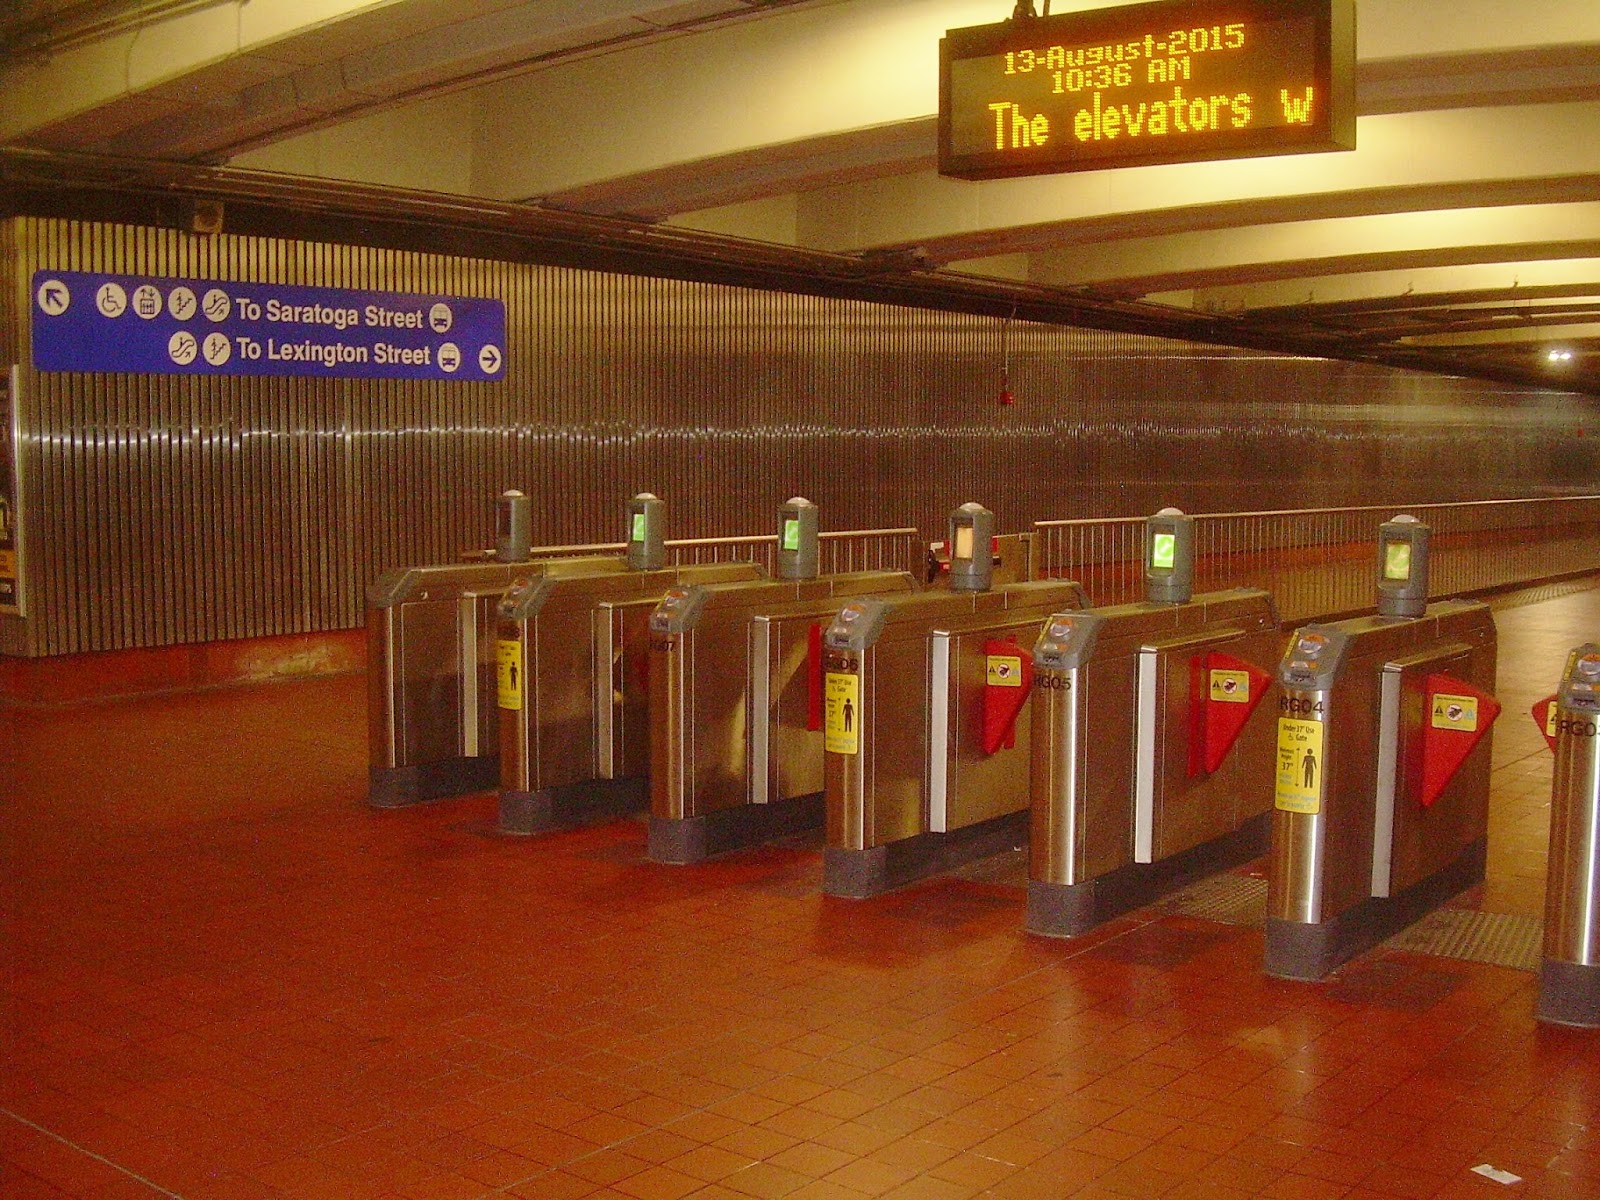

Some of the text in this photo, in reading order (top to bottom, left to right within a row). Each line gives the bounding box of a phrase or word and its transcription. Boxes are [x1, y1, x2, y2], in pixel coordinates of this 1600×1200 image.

[1004, 23, 1245, 75] 13-August-2015
[1052, 55, 1191, 94] 10:36 AM
[988, 101, 1049, 150] The
[1074, 86, 1252, 142] elevators
[235, 297, 424, 331] To Saratoga Street
[235, 336, 431, 368] To Lexington Street
[1560, 719, 1600, 738] RG0
